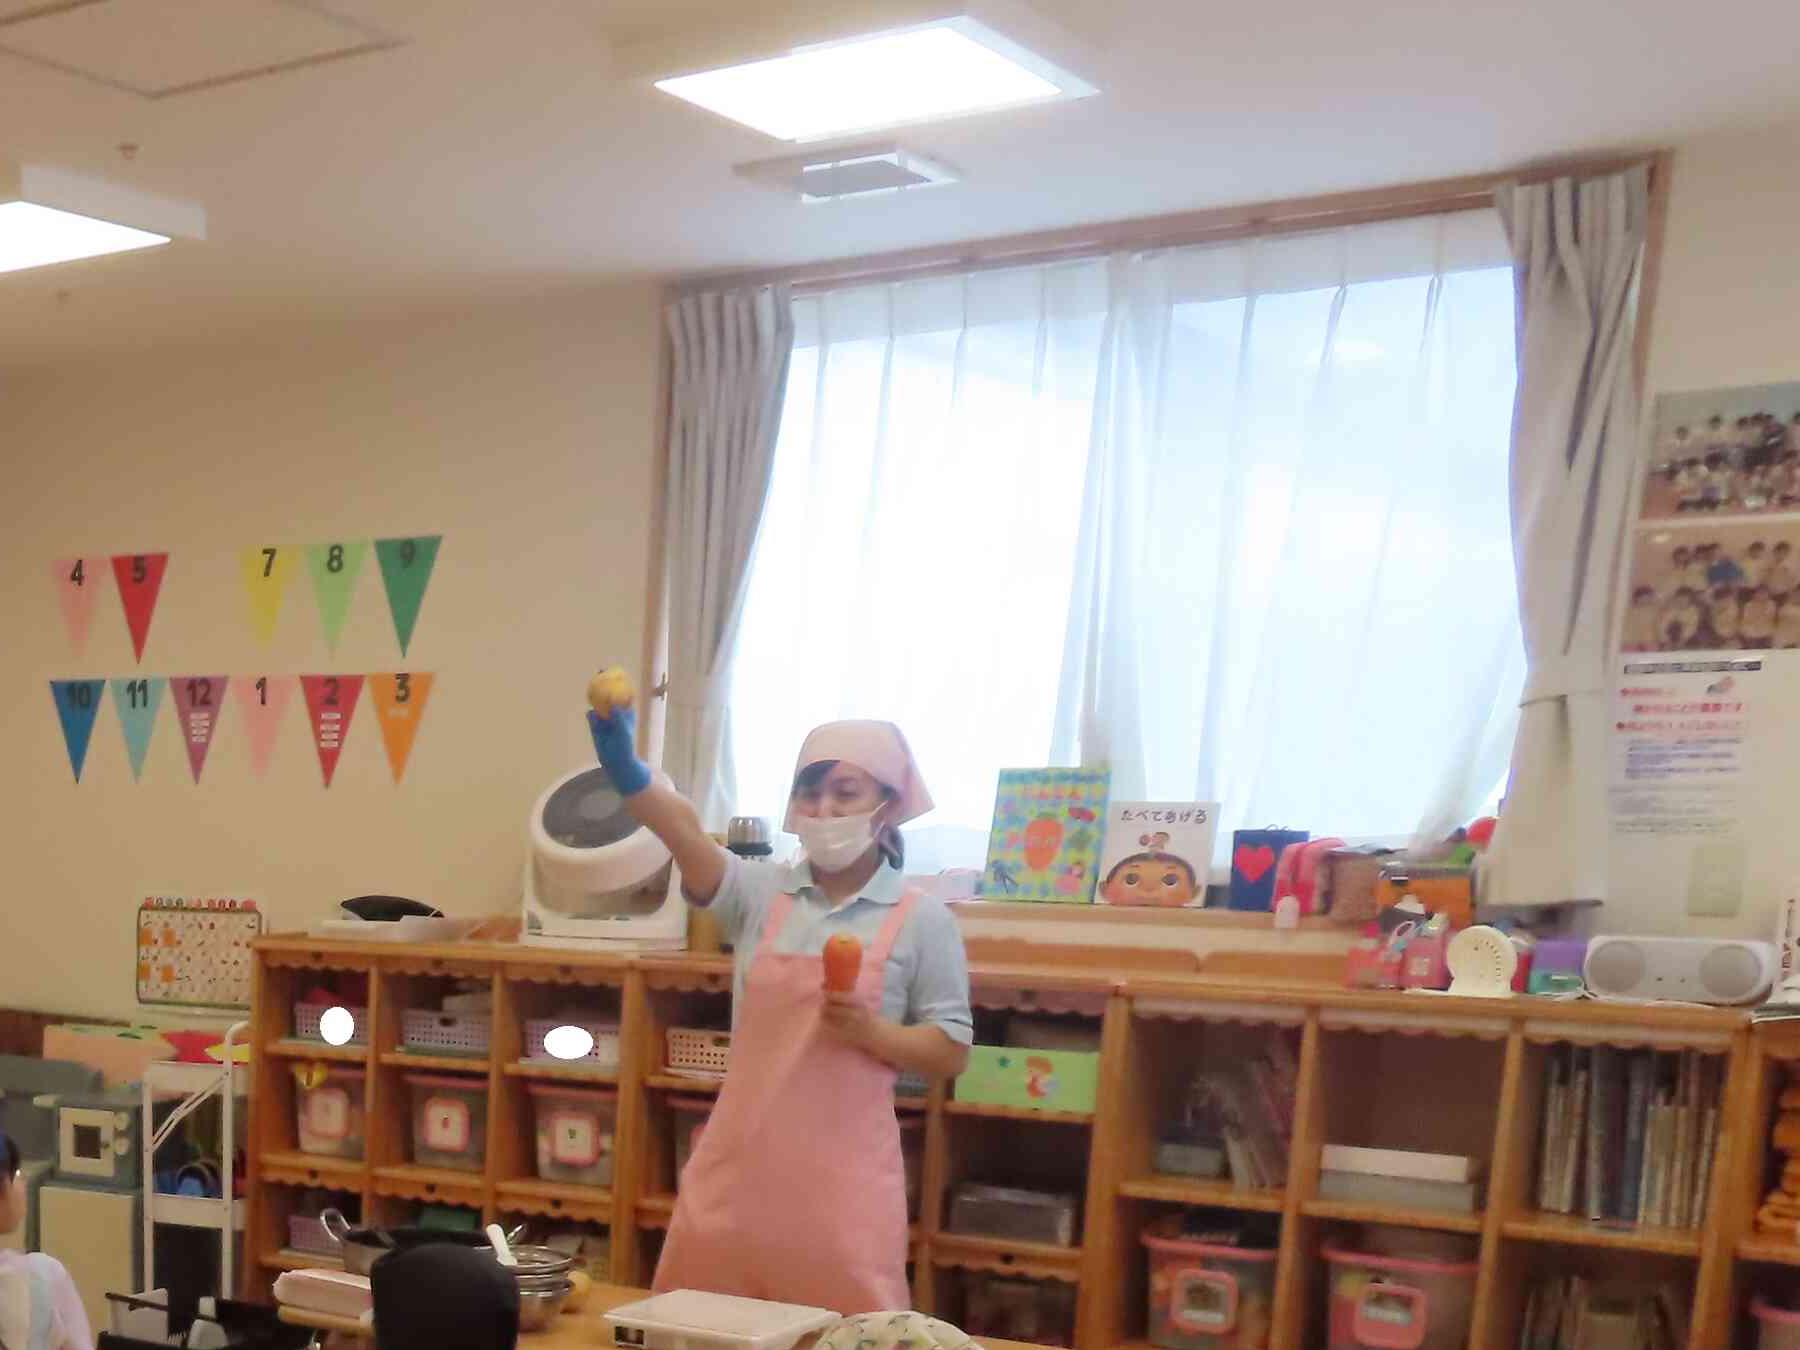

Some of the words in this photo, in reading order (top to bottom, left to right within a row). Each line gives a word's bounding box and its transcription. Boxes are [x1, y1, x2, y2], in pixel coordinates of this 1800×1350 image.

[69, 558, 85, 587] 4
[131, 556, 146, 584] 5
[261, 547, 277, 578] 7
[326, 544, 344, 574] 8
[399, 540, 416, 568] 9
[66, 683, 92, 710] 10
[126, 680, 149, 708] 11
[186, 679, 212, 707] 12
[255, 677, 269, 706] 1
[322, 678, 339, 706] 2
[394, 673, 410, 702] 3
[1120, 808, 1208, 825] たべてあげる
